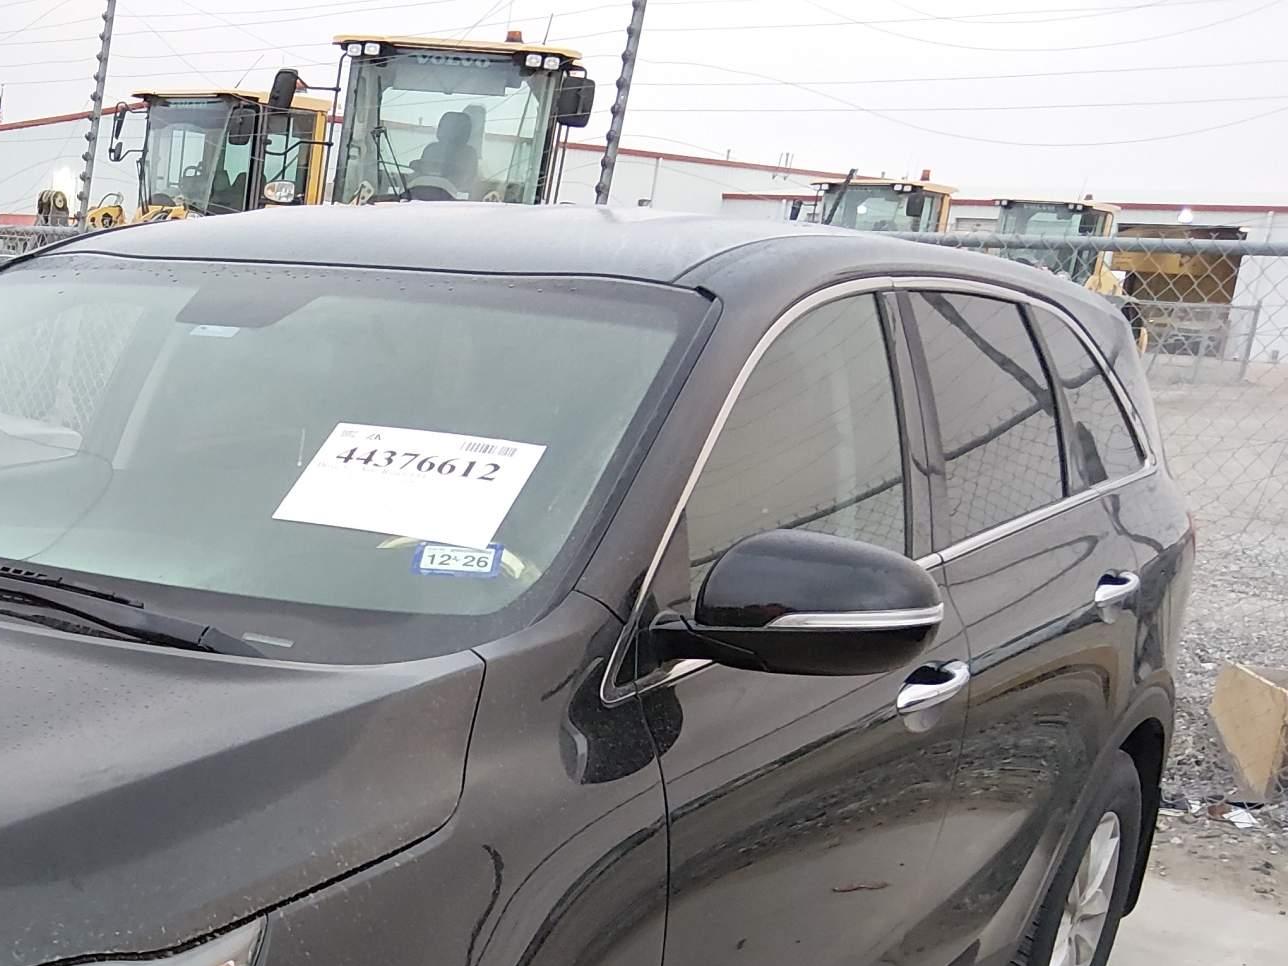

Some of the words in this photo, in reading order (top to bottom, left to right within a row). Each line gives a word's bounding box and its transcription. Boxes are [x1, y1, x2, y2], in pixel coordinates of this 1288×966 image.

[416, 54, 491, 69] VOLVO
[335, 447, 501, 482] 44376612
[427, 553, 452, 566] 12
[462, 555, 490, 569] 26
